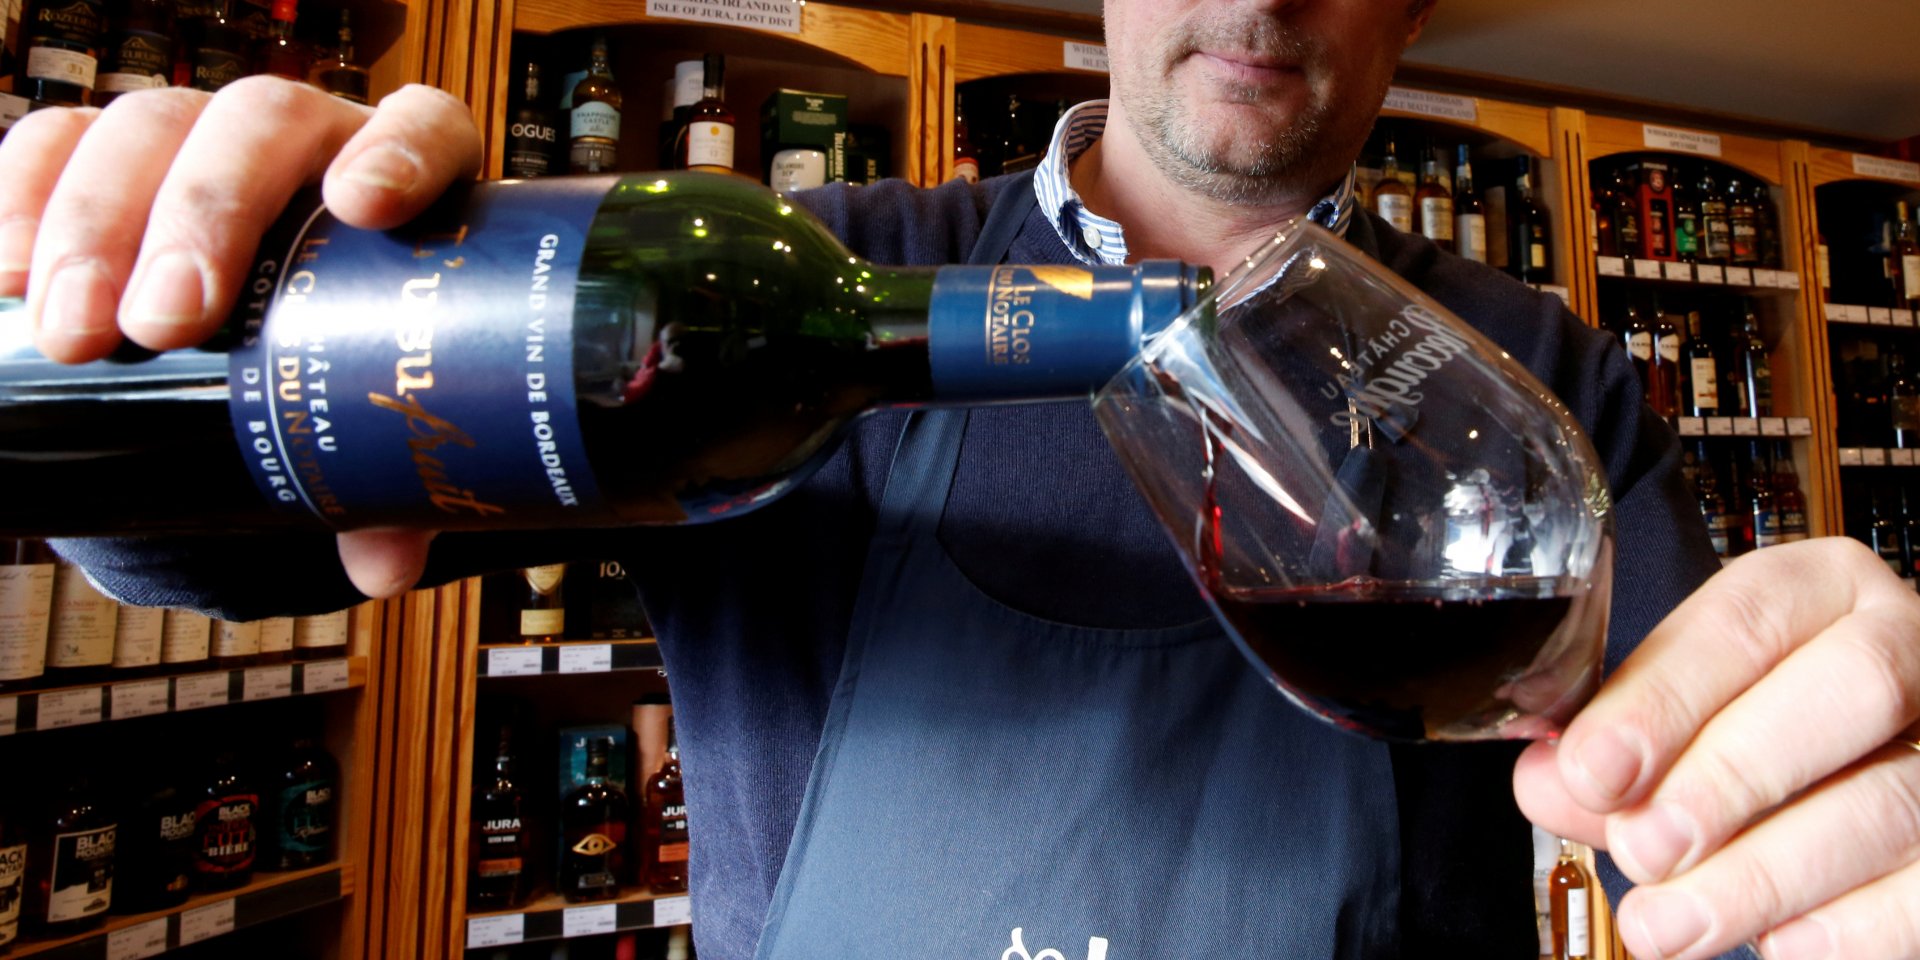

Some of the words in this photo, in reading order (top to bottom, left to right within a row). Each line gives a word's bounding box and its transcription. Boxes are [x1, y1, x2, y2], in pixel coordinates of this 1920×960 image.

[653, 2, 681, 13] ISLE
[682, 6, 698, 15] OF
[701, 8, 734, 21] JURA,
[736, 12, 766, 24] LOST
[768, 17, 795, 27] DIST
[722, 0, 791, 14] IRLANDAIS
[1072, 44, 1109, 56] WHISK
[1082, 57, 1110, 69] BLEN
[511, 123, 556, 143] OGUES
[528, 233, 559, 311] GRAND
[278, 269, 316, 348] CLS
[1013, 285, 1036, 306] LE
[526, 319, 545, 362] VIN
[991, 286, 1014, 366] NOTAIRE
[1011, 309, 1035, 365] CLOS
[241, 367, 262, 403] DE
[277, 356, 302, 402] DU
[306, 334, 338, 452] HÂTEAU
[526, 372, 548, 403] DE
[247, 420, 298, 502] BOURG
[531, 410, 579, 507] BORDEAUX
[160, 811, 197, 829] BLAC
[483, 817, 522, 831] JURA
[662, 805, 688, 817] JUR
[76, 831, 116, 850] BLAC
